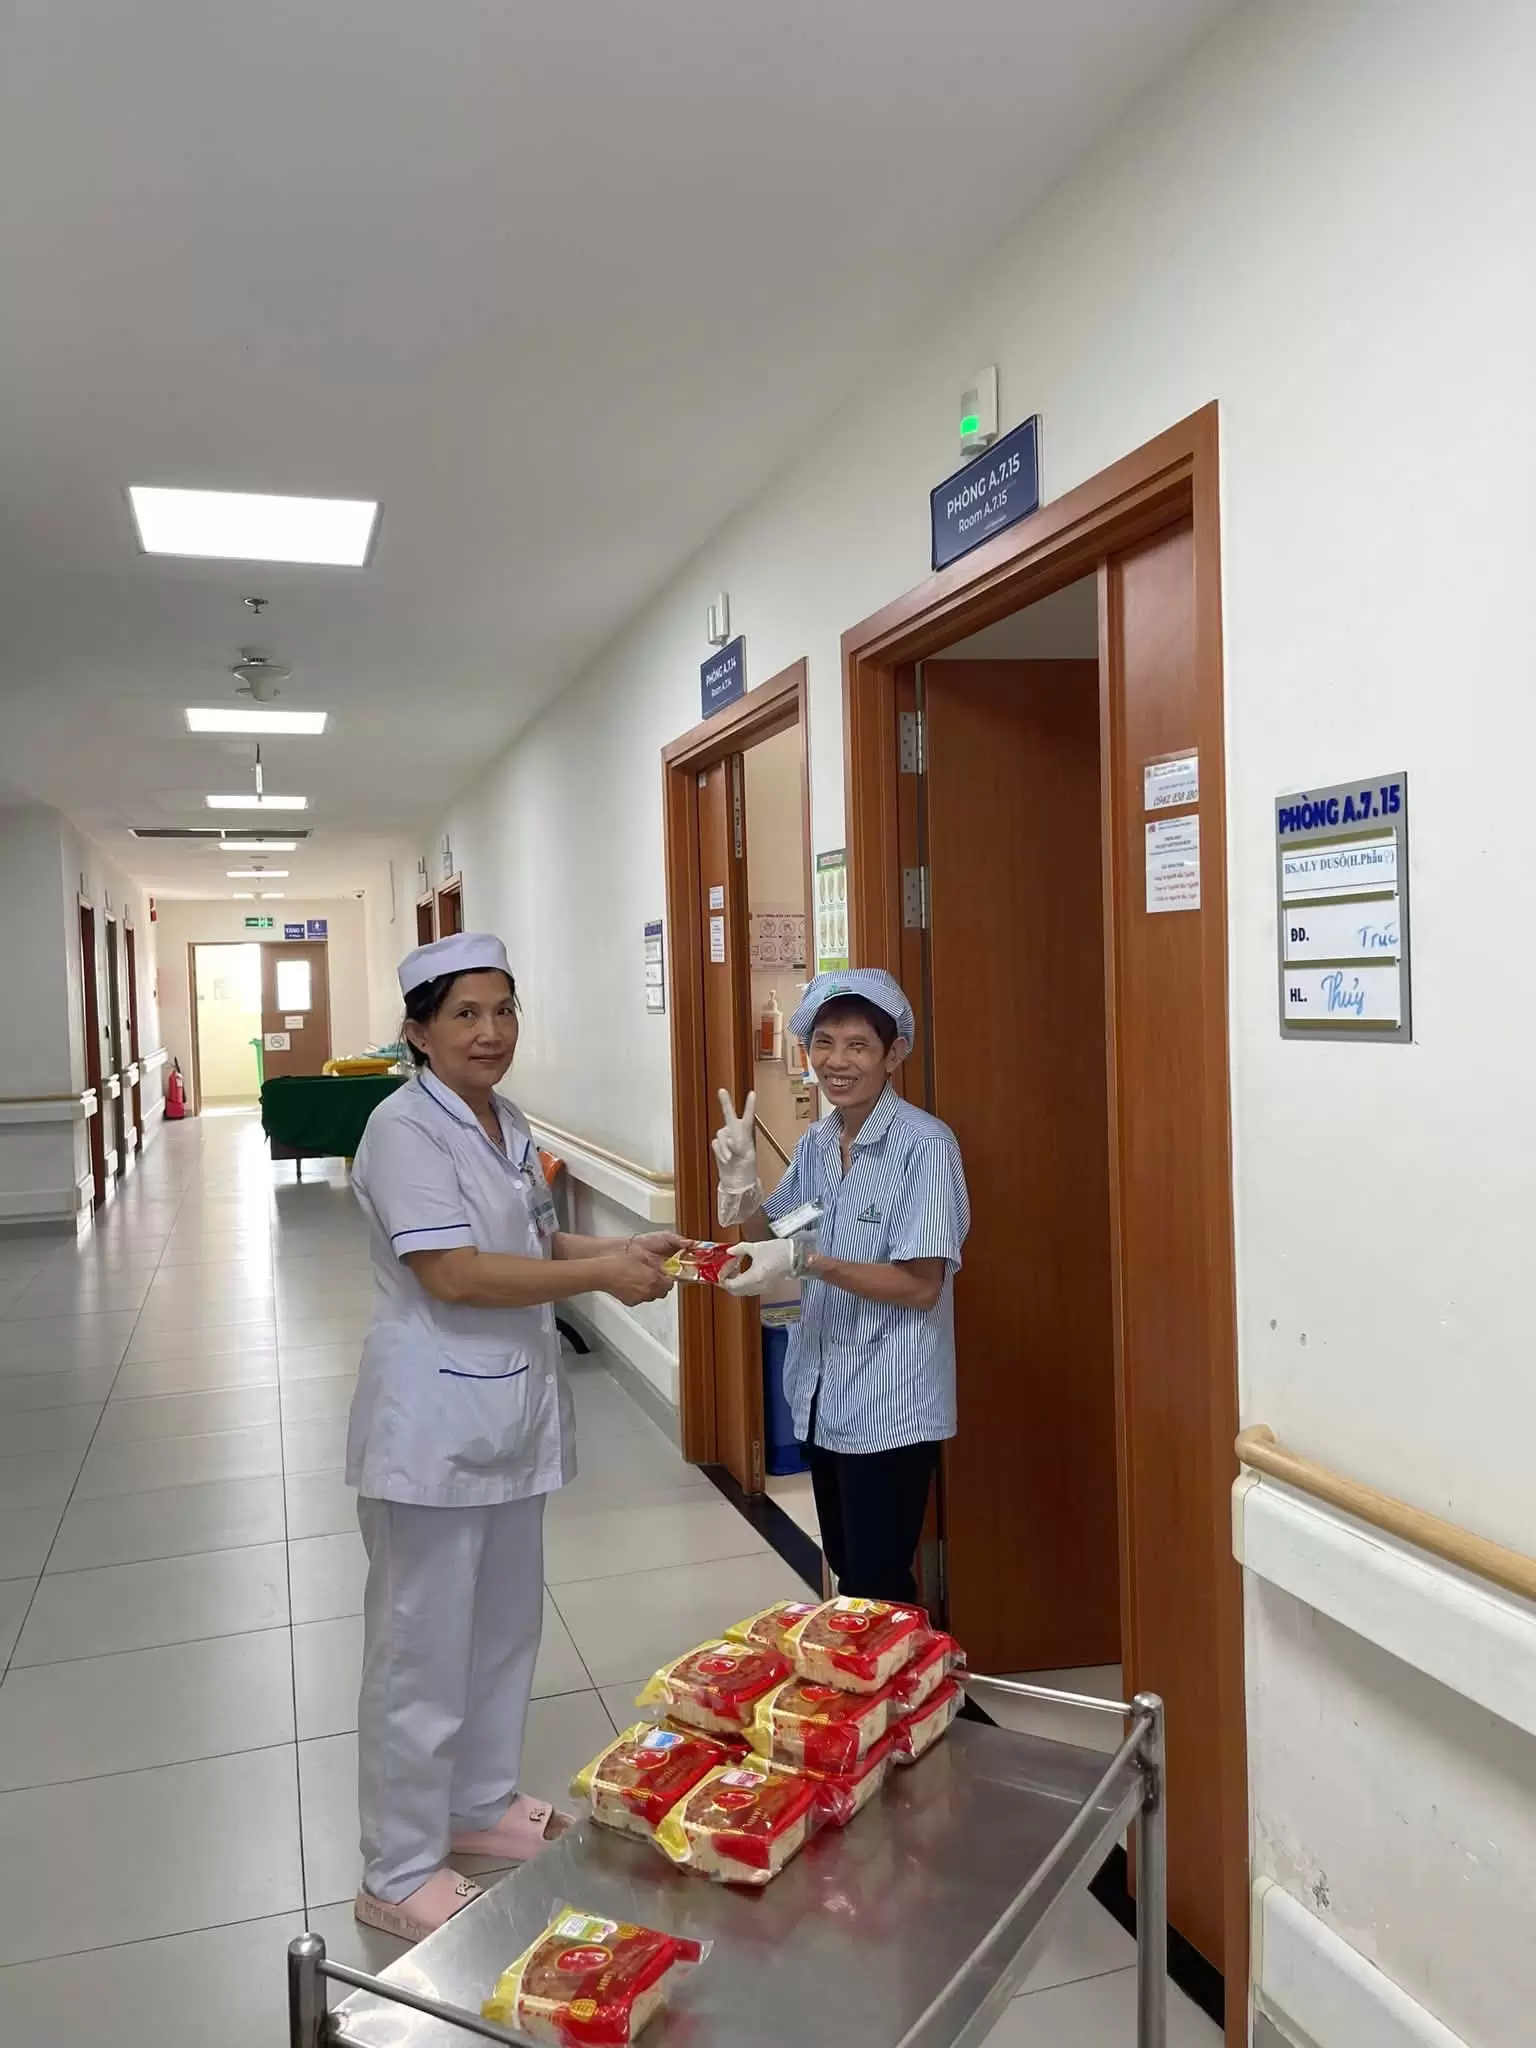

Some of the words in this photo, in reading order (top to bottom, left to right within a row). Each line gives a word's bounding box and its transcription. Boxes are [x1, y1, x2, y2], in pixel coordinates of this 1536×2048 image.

[947, 477, 986, 519] PHÒNG
[988, 452, 1020, 491] A.7.15
[958, 509, 983, 534] Room
[984, 489, 1008, 517] A.7.15
[1278, 795, 1339, 834] PHÒNG
[1342, 784, 1400, 824] A.7.15
[1290, 987, 1308, 1003] HL.
